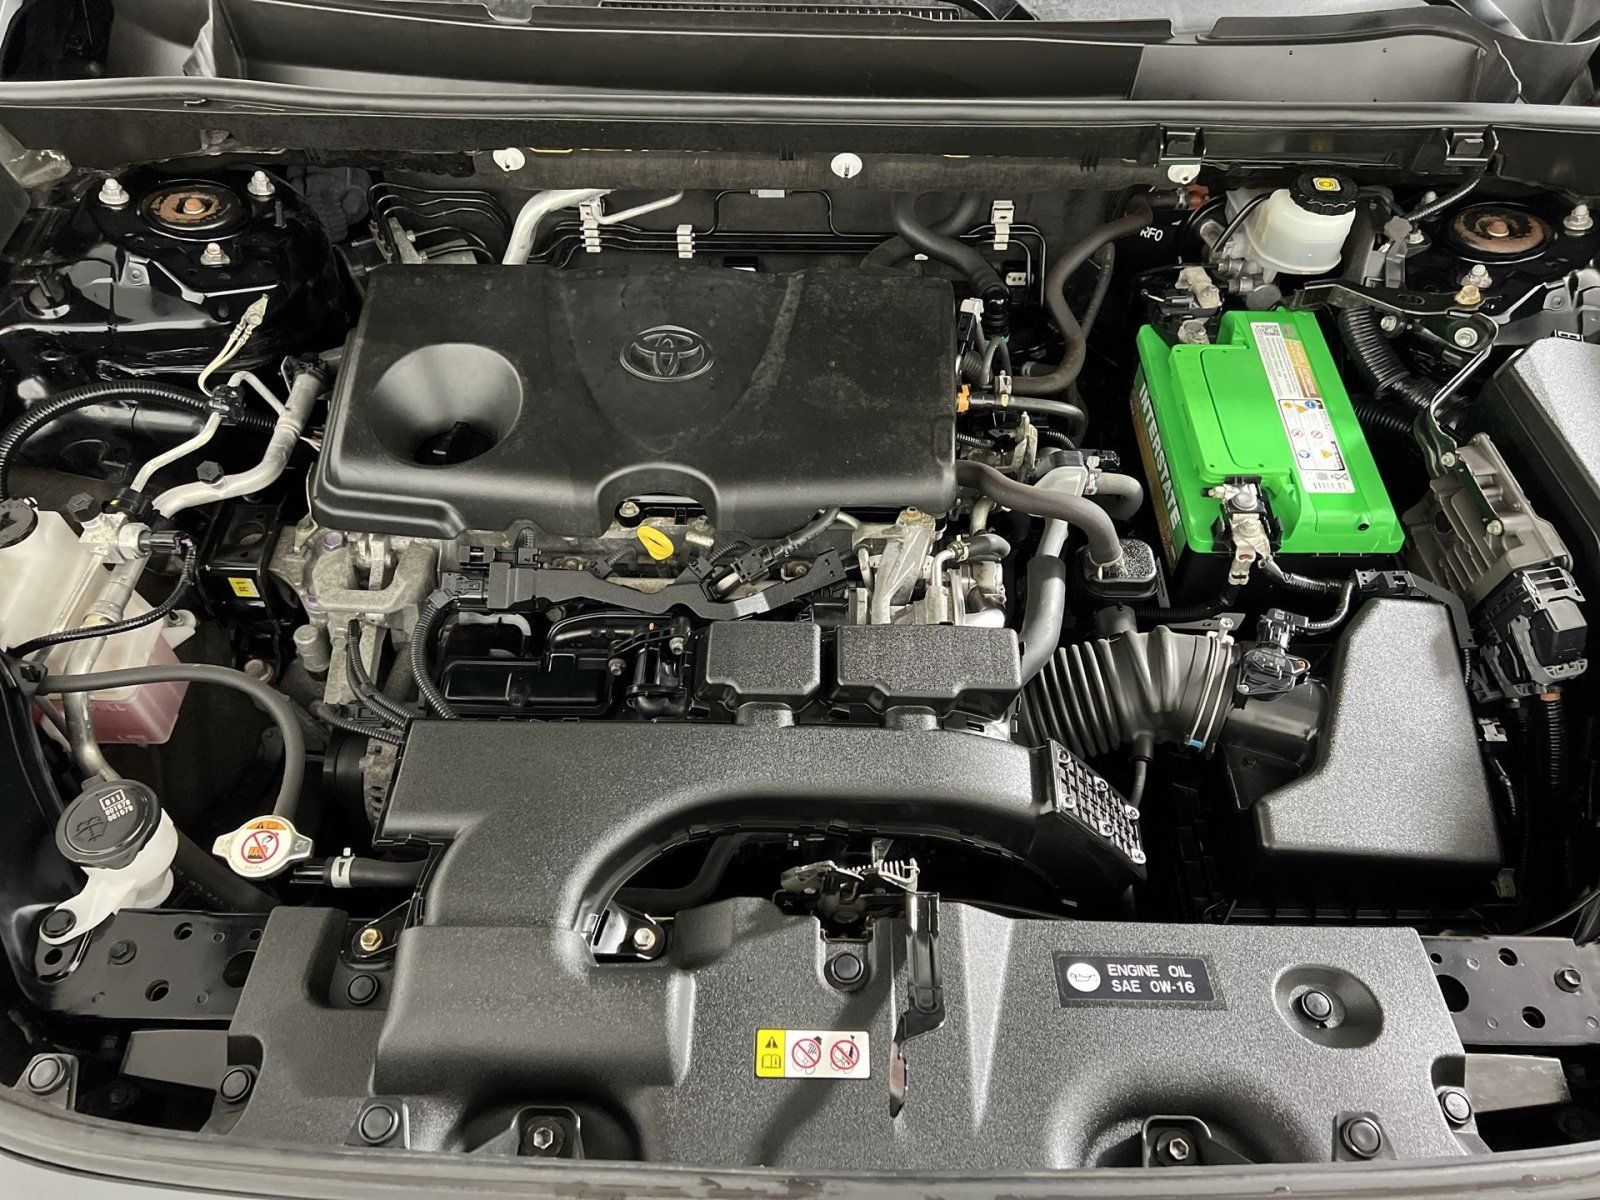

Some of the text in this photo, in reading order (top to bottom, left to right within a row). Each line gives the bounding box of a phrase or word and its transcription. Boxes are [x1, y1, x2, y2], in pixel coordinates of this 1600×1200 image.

[1139, 382, 1181, 530] INTERSTATE
[1107, 963, 1193, 978] ENGINE OIL
[1111, 979, 1196, 994] SAE 0W-16
